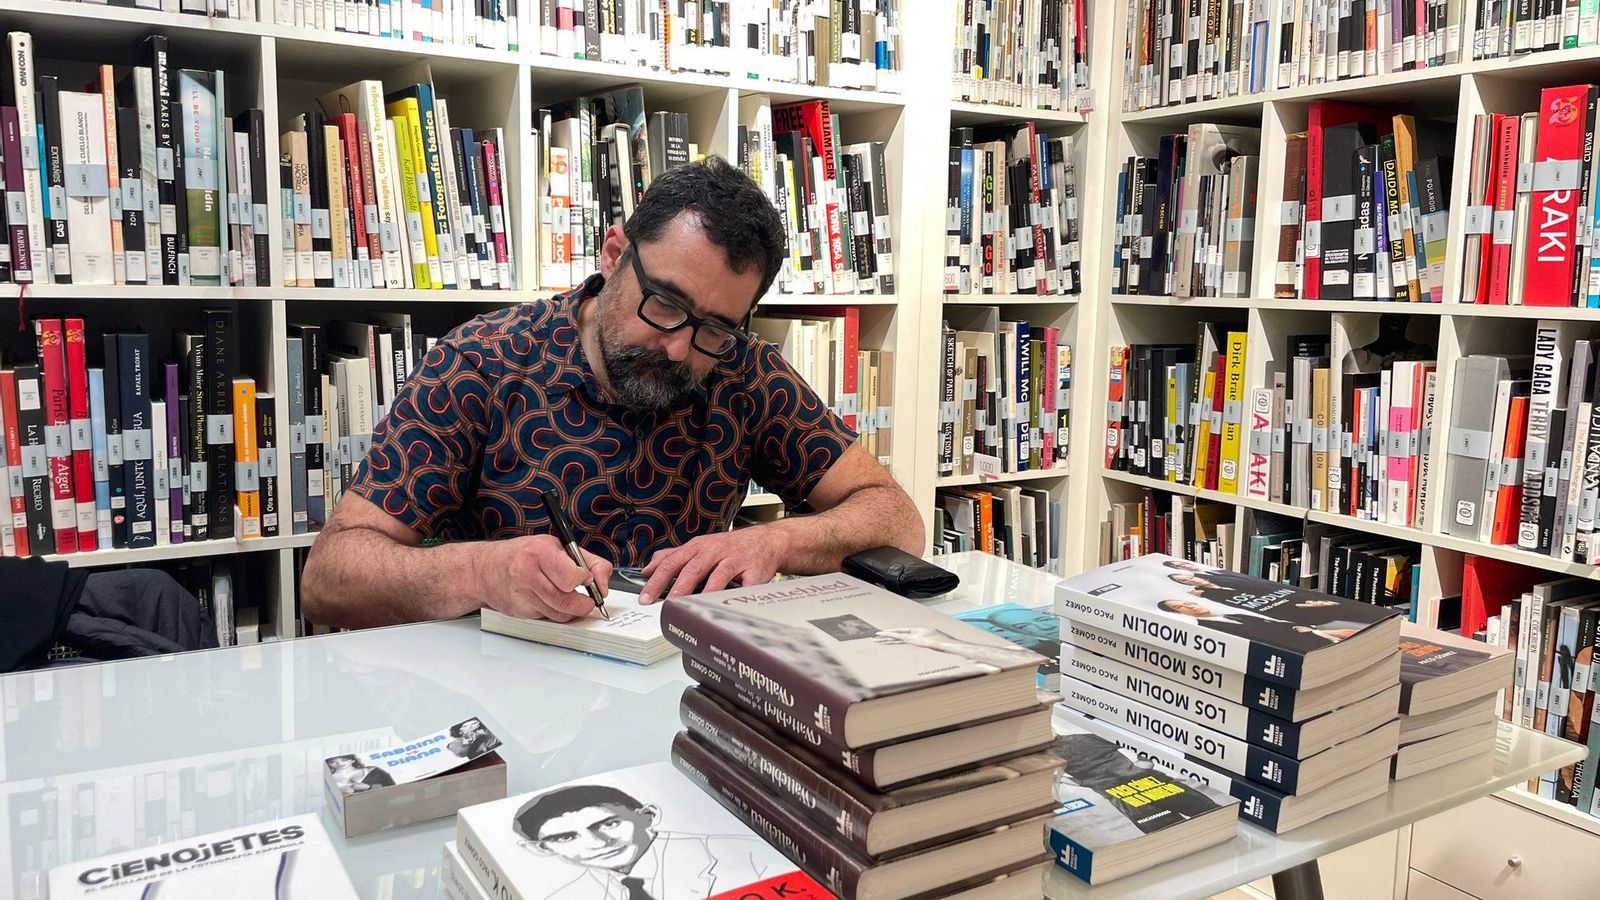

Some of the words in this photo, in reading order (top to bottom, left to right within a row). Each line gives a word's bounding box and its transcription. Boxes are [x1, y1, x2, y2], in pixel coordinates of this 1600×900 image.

[77, 111, 85, 135] BLANCO
[161, 99, 170, 129] PARIS
[773, 105, 804, 131] FREE
[820, 100, 834, 147] WILLIAM
[162, 134, 170, 147] BY
[424, 110, 438, 152] básica
[1504, 126, 1512, 143] boris
[377, 143, 386, 174] Cultura
[1584, 132, 1593, 163] CUEVAS
[403, 158, 413, 175] Karl
[825, 149, 836, 180] KLEIN
[427, 152, 446, 219] Fotografía
[1386, 162, 1397, 197] DAIDO
[405, 176, 417, 211] Blossfeldt
[1427, 178, 1436, 212] POLAROID
[56, 220, 65, 238] CAST
[829, 208, 840, 234] YORK
[1537, 189, 1571, 262] RAKI
[17, 229, 28, 270] SANCTORVM
[166, 236, 176, 275] BULFINCH
[195, 343, 204, 367] Vivian
[215, 320, 226, 364] DIANE
[947, 337, 955, 368] SKETCH
[1231, 341, 1242, 368] Dirk
[1536, 328, 1557, 359] LADY
[195, 369, 204, 390] Maier
[947, 368, 954, 378] OF
[1532, 363, 1553, 395] GAGA
[196, 391, 204, 413] Street
[216, 371, 227, 415] ARBUS
[945, 378, 954, 402] PARIS
[1529, 401, 1550, 440] TERRY
[56, 463, 71, 494] Atget
[217, 444, 229, 523] VELATIONS
[266, 476, 274, 496] maner
[32, 478, 43, 511] RECREO
[266, 497, 274, 512] Otra
[1065, 599, 1093, 614] GÓMEZ
[1225, 592, 1256, 604] LOS
[1242, 588, 1296, 610] MODLIN
[1093, 608, 1115, 621] PACO
[684, 631, 698, 647] PACO
[1070, 625, 1096, 642] GÓMEZ
[1097, 634, 1117, 648] PACO
[1122, 613, 1187, 646] MODLIN
[1124, 641, 1186, 676] MODLIN
[1193, 636, 1226, 658] LOS
[1071, 658, 1097, 674] GÓMEZ
[1099, 668, 1119, 682] PACO
[1192, 664, 1223, 688] LOS
[738, 661, 795, 707] Wattebled
[1126, 675, 1189, 710] MODLIN
[1071, 690, 1097, 707] GÓMEZ
[1098, 700, 1119, 714] PACO
[764, 701, 822, 746] Wattebled
[1195, 701, 1227, 724] LOS
[1126, 708, 1189, 746] MODLIN
[387, 747, 442, 767] DIANA
[1194, 736, 1226, 760] LOS
[760, 758, 816, 810] Wattebled
[750, 809, 807, 864] Wattebled
